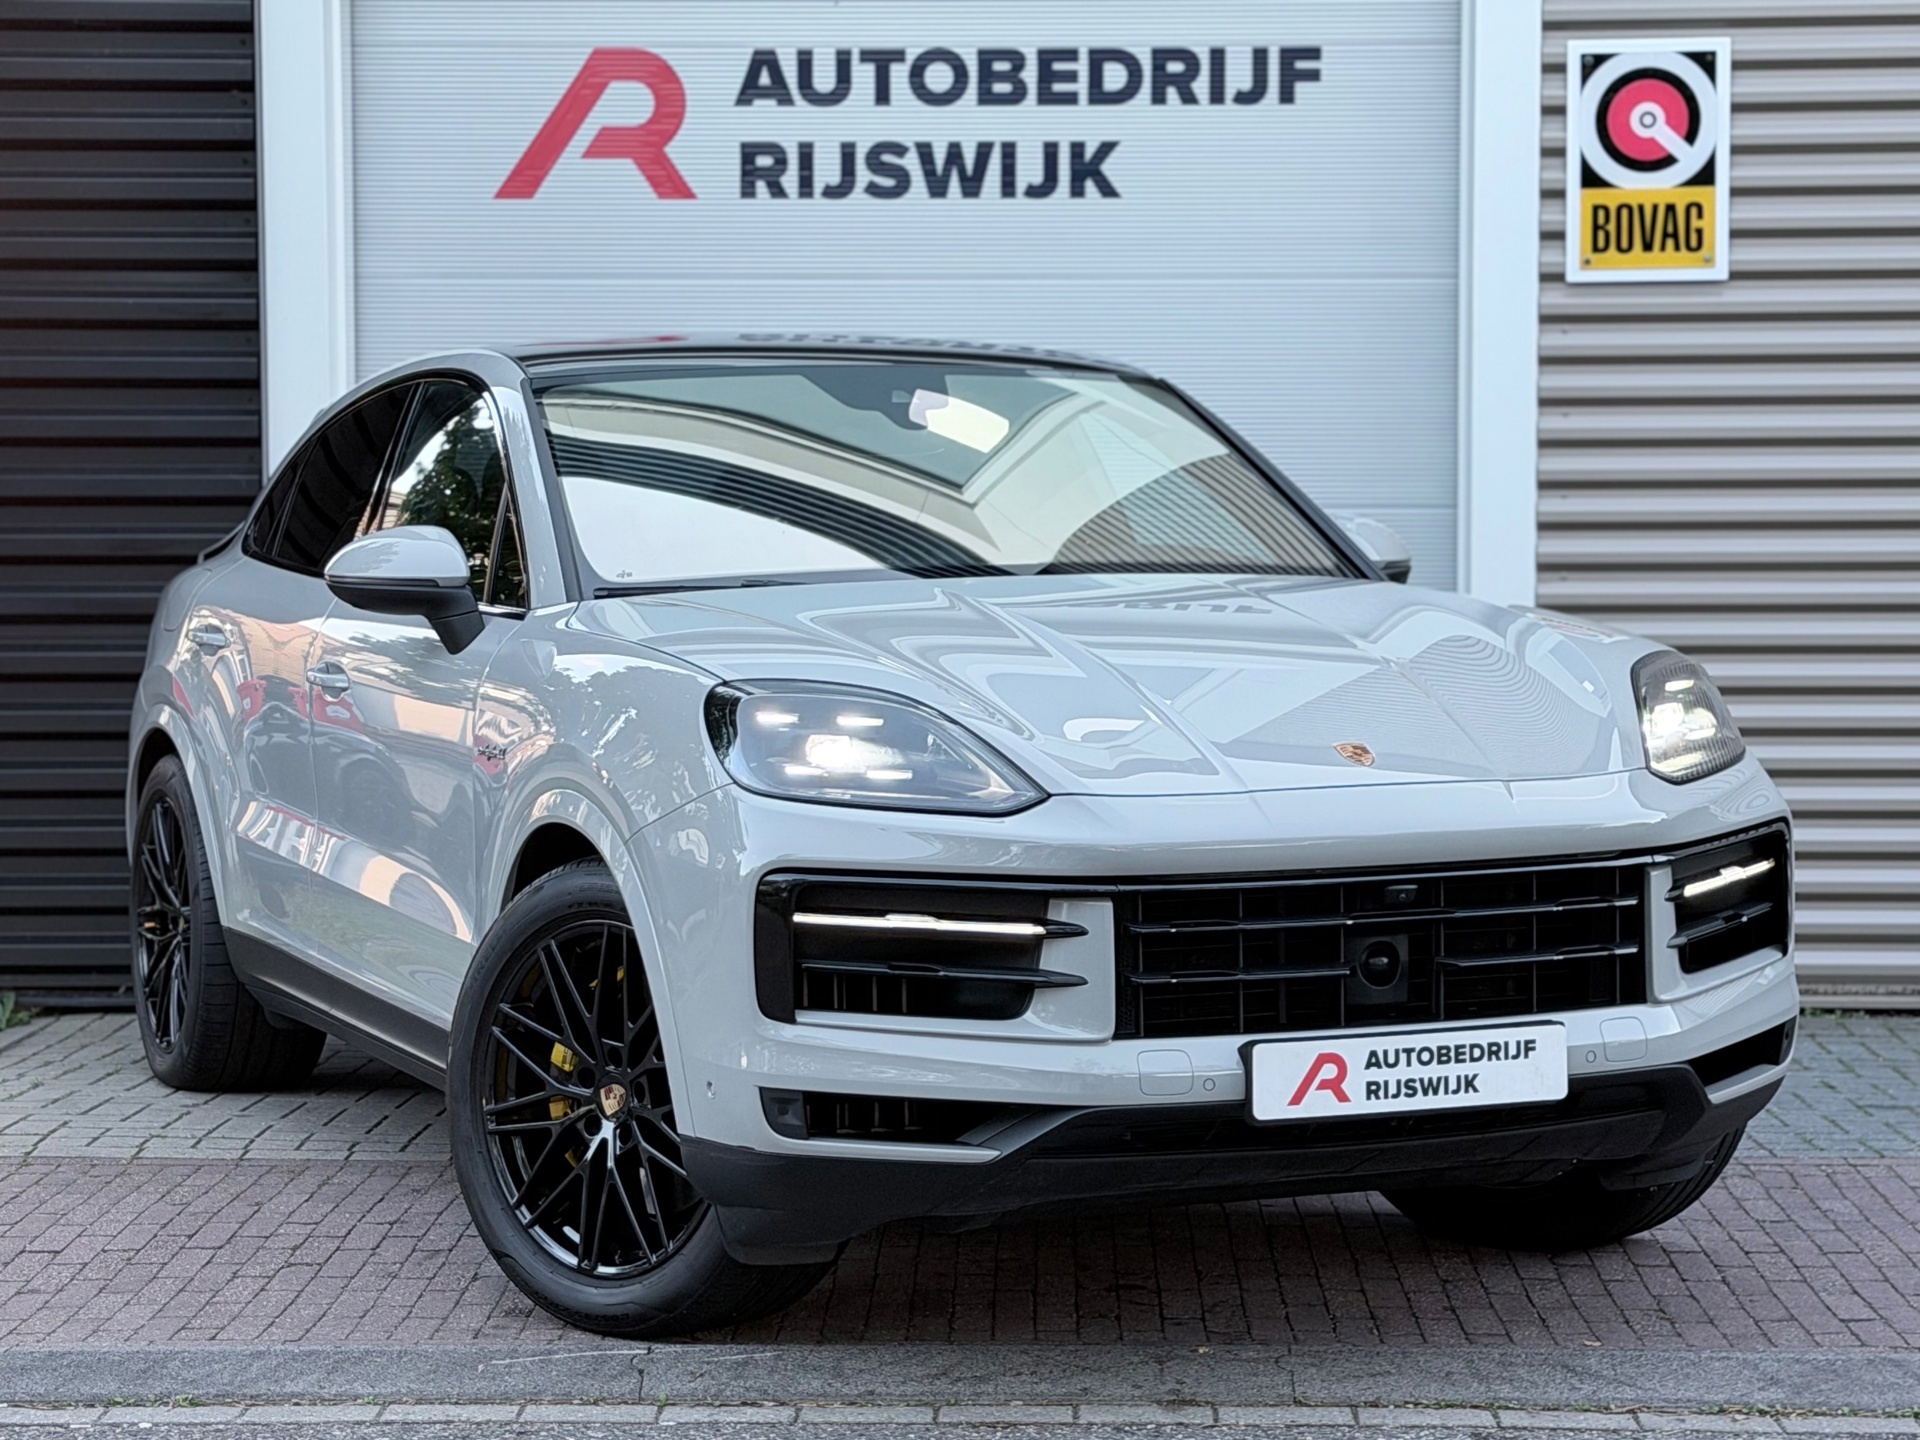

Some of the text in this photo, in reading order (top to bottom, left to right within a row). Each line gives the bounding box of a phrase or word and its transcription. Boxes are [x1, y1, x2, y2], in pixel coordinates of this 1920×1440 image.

[734, 46, 1322, 107] AUTOBEDRIJF
[739, 141, 1121, 200] RIJSWIJK
[1591, 202, 1704, 254] BOVAG
[1363, 1039, 1537, 1070] AUTOBEDRIJF
[1365, 1074, 1480, 1101] RIJSWIJK
